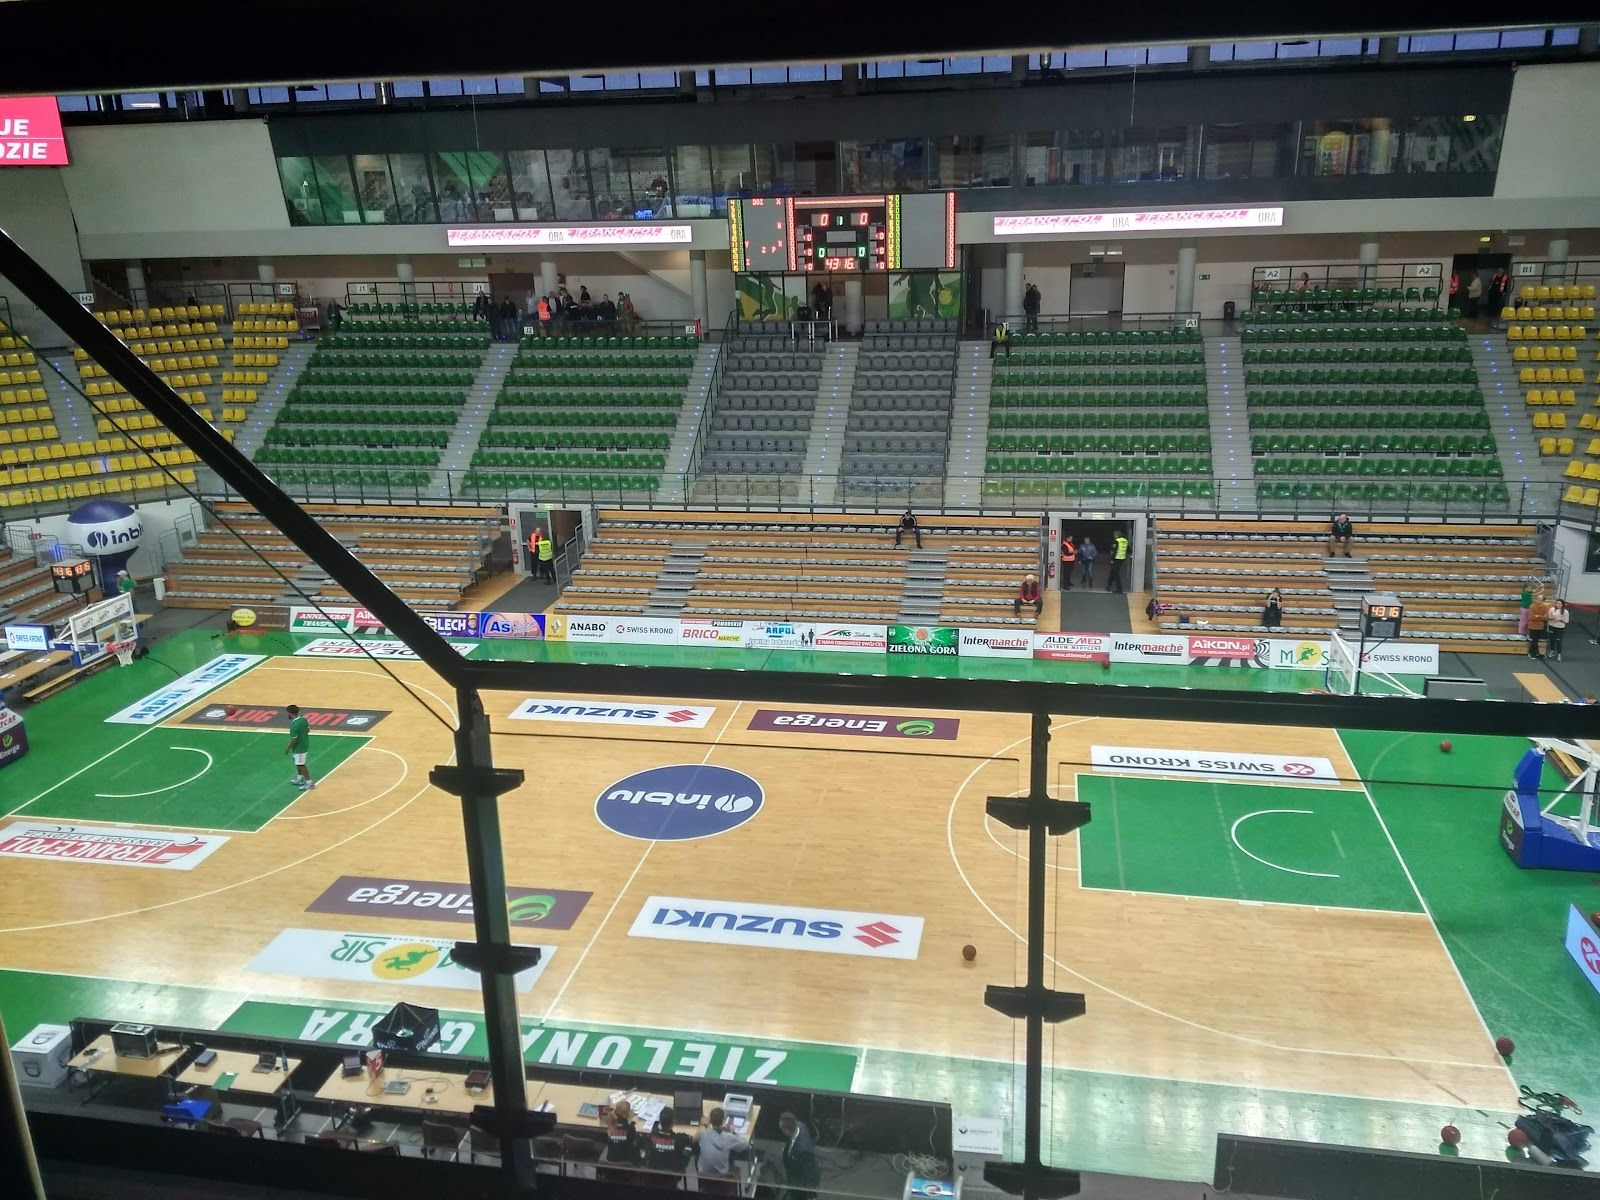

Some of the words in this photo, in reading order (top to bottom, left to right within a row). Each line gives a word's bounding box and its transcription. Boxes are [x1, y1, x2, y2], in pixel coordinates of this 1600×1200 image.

[820, 214, 829, 226] 0
[860, 212, 868, 225] 0
[818, 248, 825, 257] 0
[858, 247, 865, 257] 0
[1267, 270, 1278, 278] A2
[1418, 266, 1431, 274] A2
[1522, 265, 1533, 274] B1
[281, 285, 293, 294] H2
[570, 622, 606, 631] ANABO
[683, 629, 718, 638] BRICO
[964, 636, 1028, 648] Intermarché
[1114, 641, 1184, 654] Intermarché
[889, 645, 927, 653] ZIELONA
[930, 644, 956, 654] GÓRA
[526, 704, 659, 719] SUZUKI
[773, 714, 888, 732] Energa
[1109, 755, 1190, 768] KRONO
[1198, 759, 1275, 773] SWISS
[607, 790, 717, 810] inblu
[3, 837, 158, 861] FRANCEPOL
[652, 908, 844, 938] SUZUKI
[298, 1009, 476, 1055] GRA
